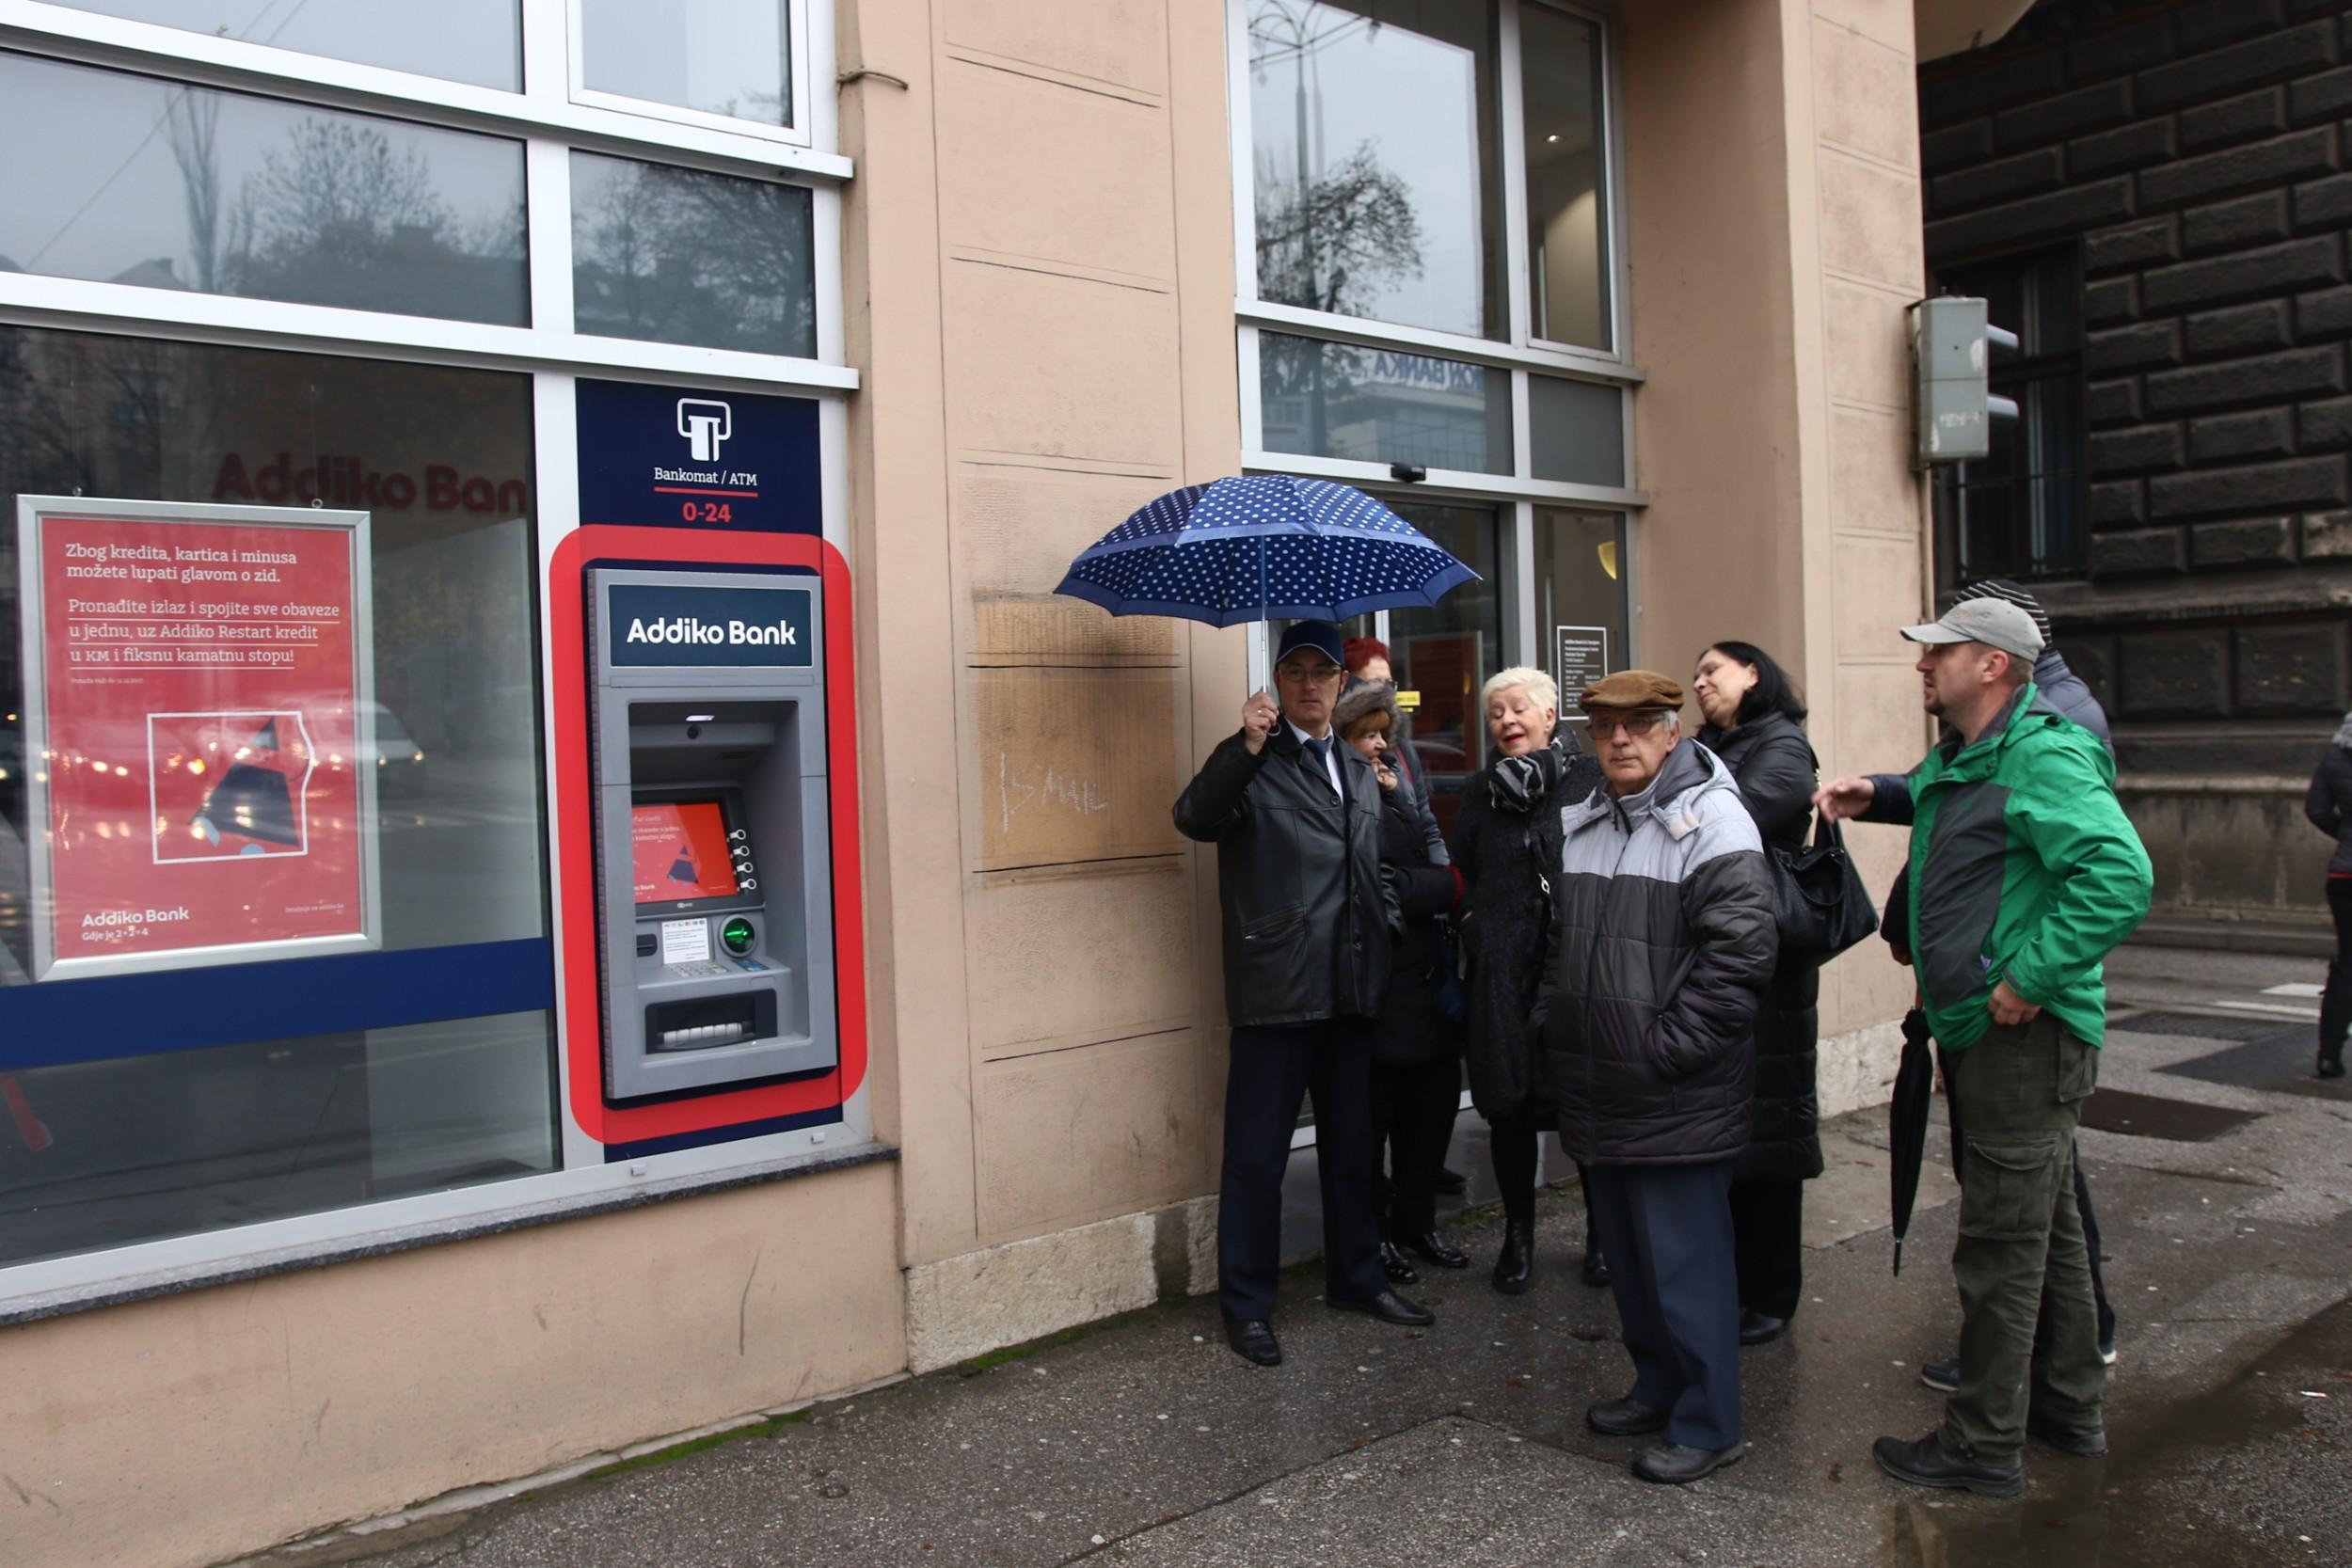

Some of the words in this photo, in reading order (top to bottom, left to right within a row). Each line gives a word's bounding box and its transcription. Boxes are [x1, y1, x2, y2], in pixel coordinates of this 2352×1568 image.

[210, 451, 418, 510] Addiko
[654, 467, 719, 483] Bankomat
[721, 469, 727, 484] /
[729, 472, 757, 486] ATM
[682, 501, 731, 522] 0-24
[66, 543, 107, 562] Zbog
[110, 545, 171, 562] kredita,
[175, 546, 229, 562] kartica
[232, 549, 238, 562] i
[241, 550, 297, 564] minusa
[67, 563, 128, 578] možete
[132, 564, 178, 582] lupati
[181, 566, 237, 583] glavom
[241, 571, 250, 581] o
[254, 568, 280, 582] zid.
[68, 598, 147, 613] Pronađite
[151, 599, 186, 614] izlaz
[190, 601, 195, 614] i
[199, 601, 249, 618] spojite
[253, 604, 278, 615] sve
[282, 602, 340, 616] obaveze
[69, 626, 80, 638] u
[83, 623, 134, 641] jednu,
[137, 626, 157, 638] uz
[160, 624, 215, 639] Addiko
[218, 625, 272, 639] Restart
[276, 625, 318, 640] kredit
[626, 617, 723, 644] Addiko
[729, 620, 796, 645] Bank
[71, 650, 81, 661] u
[114, 648, 119, 661] i
[123, 647, 174, 662] fiksnu
[177, 647, 245, 662] kamatnu
[247, 649, 294, 666] stopu!
[82, 910, 144, 928] Addiko
[146, 906, 190, 923] Bank
